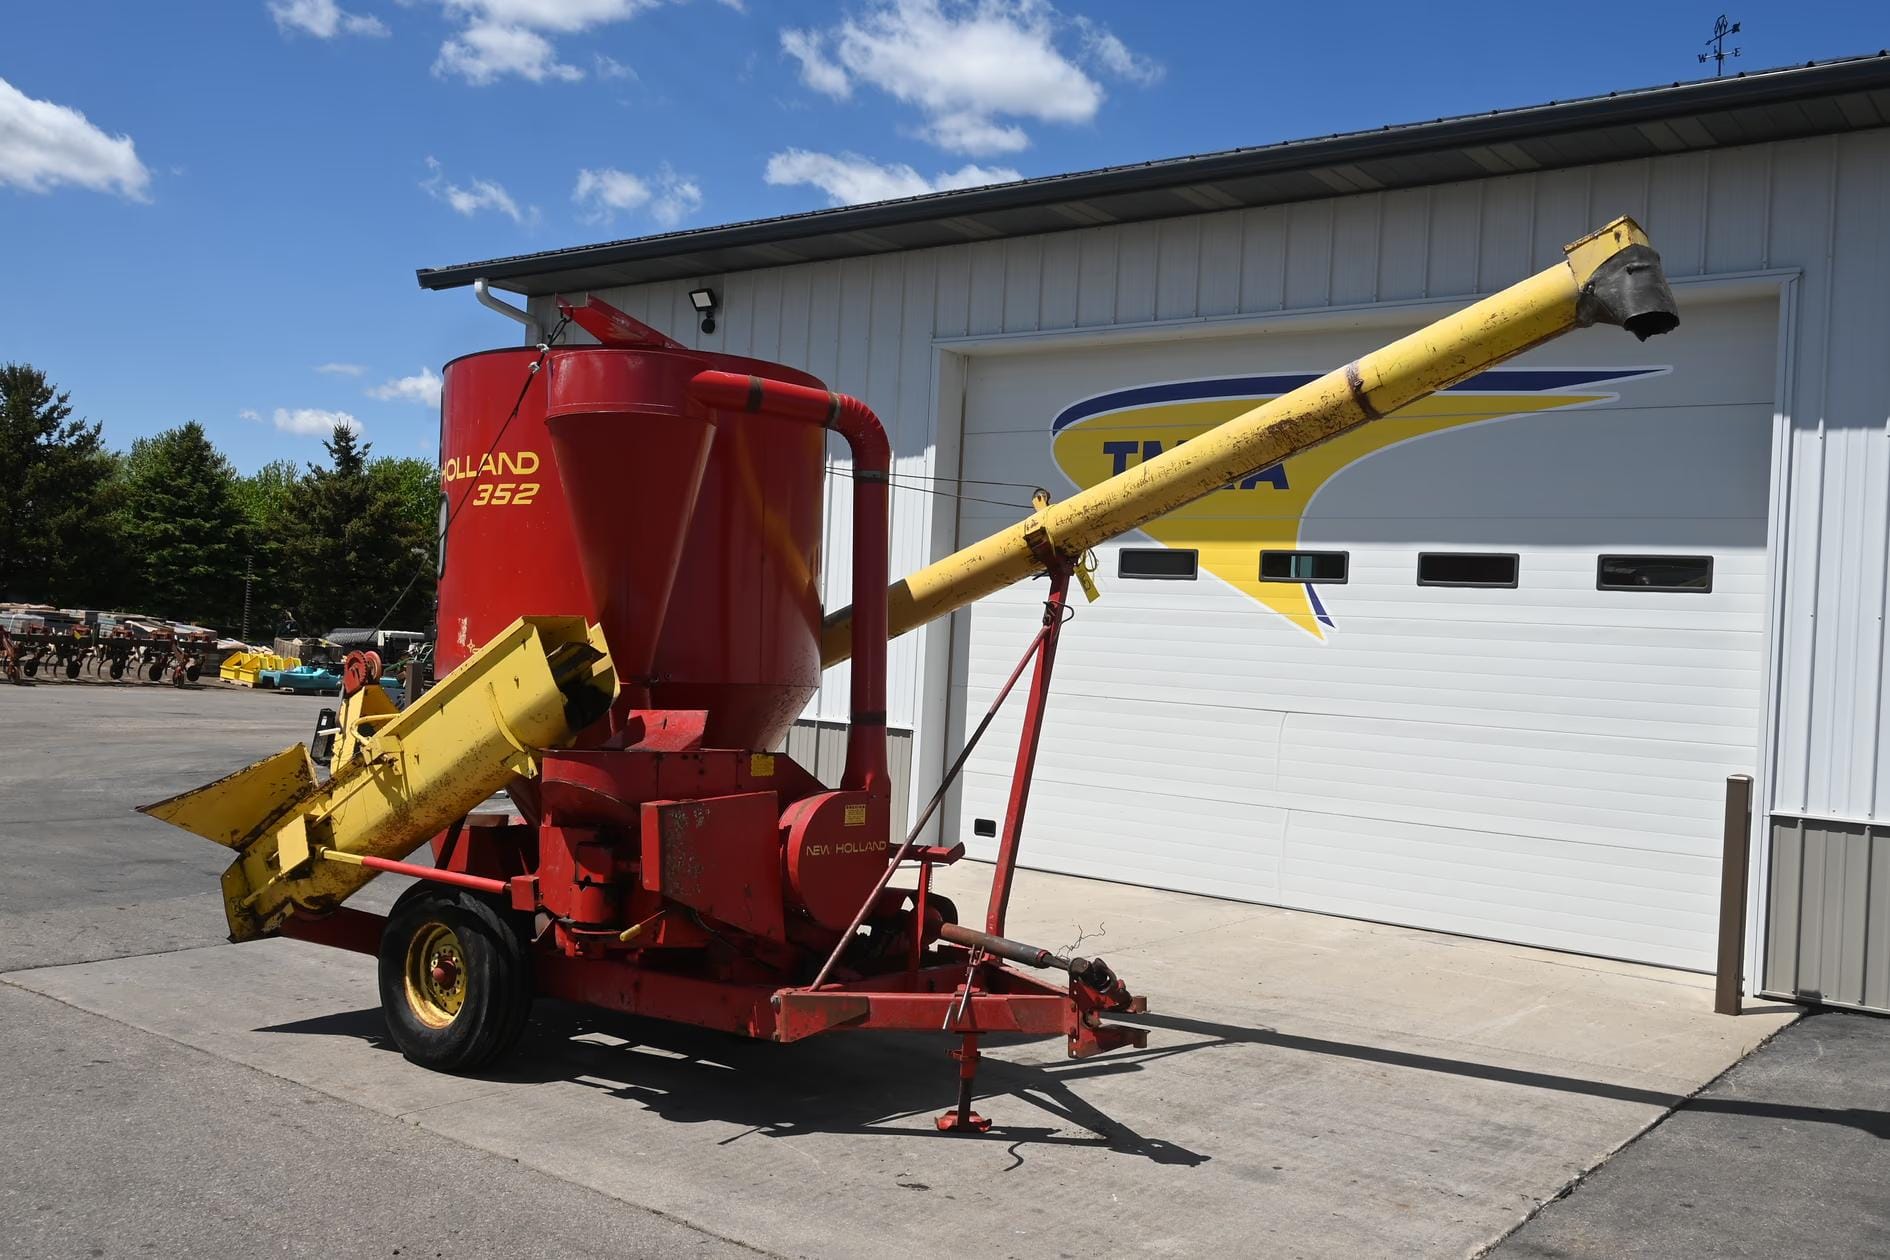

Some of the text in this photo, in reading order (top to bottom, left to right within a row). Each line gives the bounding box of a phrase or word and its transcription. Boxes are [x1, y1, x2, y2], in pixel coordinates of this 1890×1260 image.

[441, 451, 540, 484] HOLLAND
[472, 483, 541, 506] 352
[806, 840, 887, 857] NEW HOLLAND
